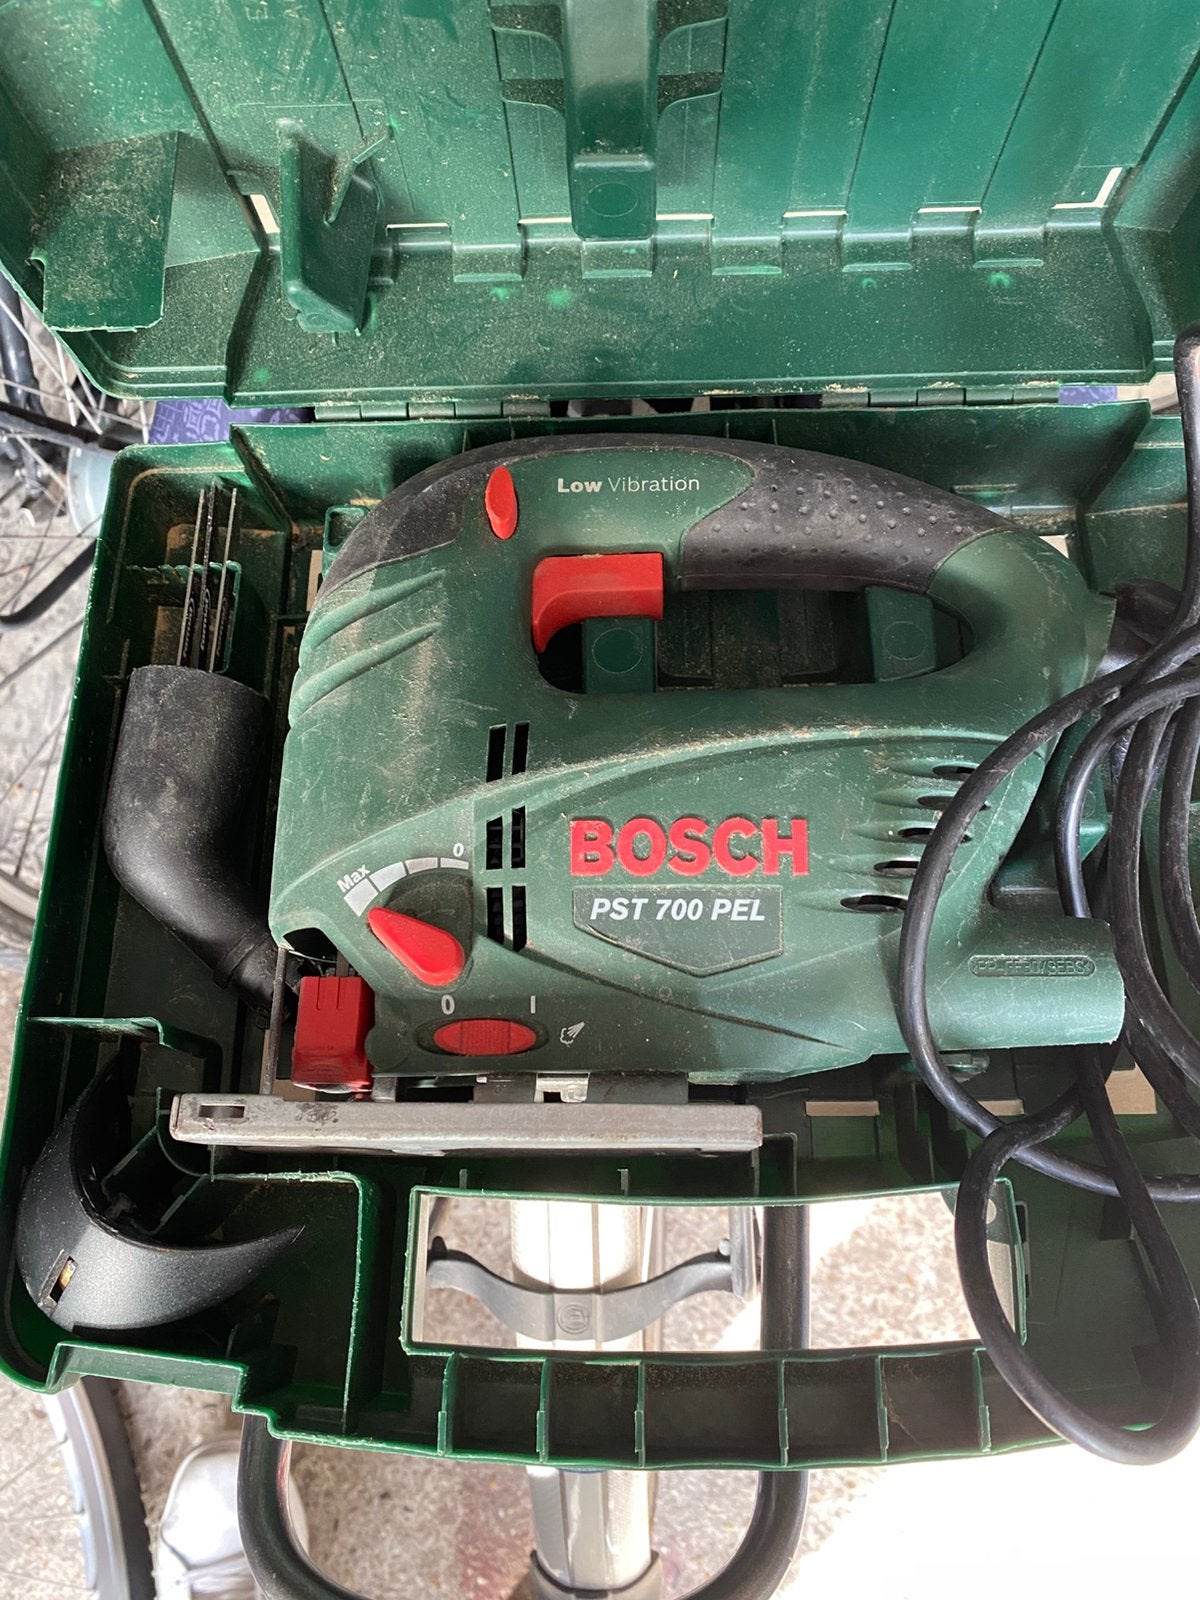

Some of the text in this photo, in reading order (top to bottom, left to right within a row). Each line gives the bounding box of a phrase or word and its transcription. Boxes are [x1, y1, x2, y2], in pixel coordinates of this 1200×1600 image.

[557, 476, 700, 493] Low Vibration
[453, 843, 465, 857] 0
[569, 816, 809, 877] BOSCH
[336, 864, 371, 893] Max
[590, 898, 766, 921] PST 700 PEL
[440, 994, 456, 1015] 0
